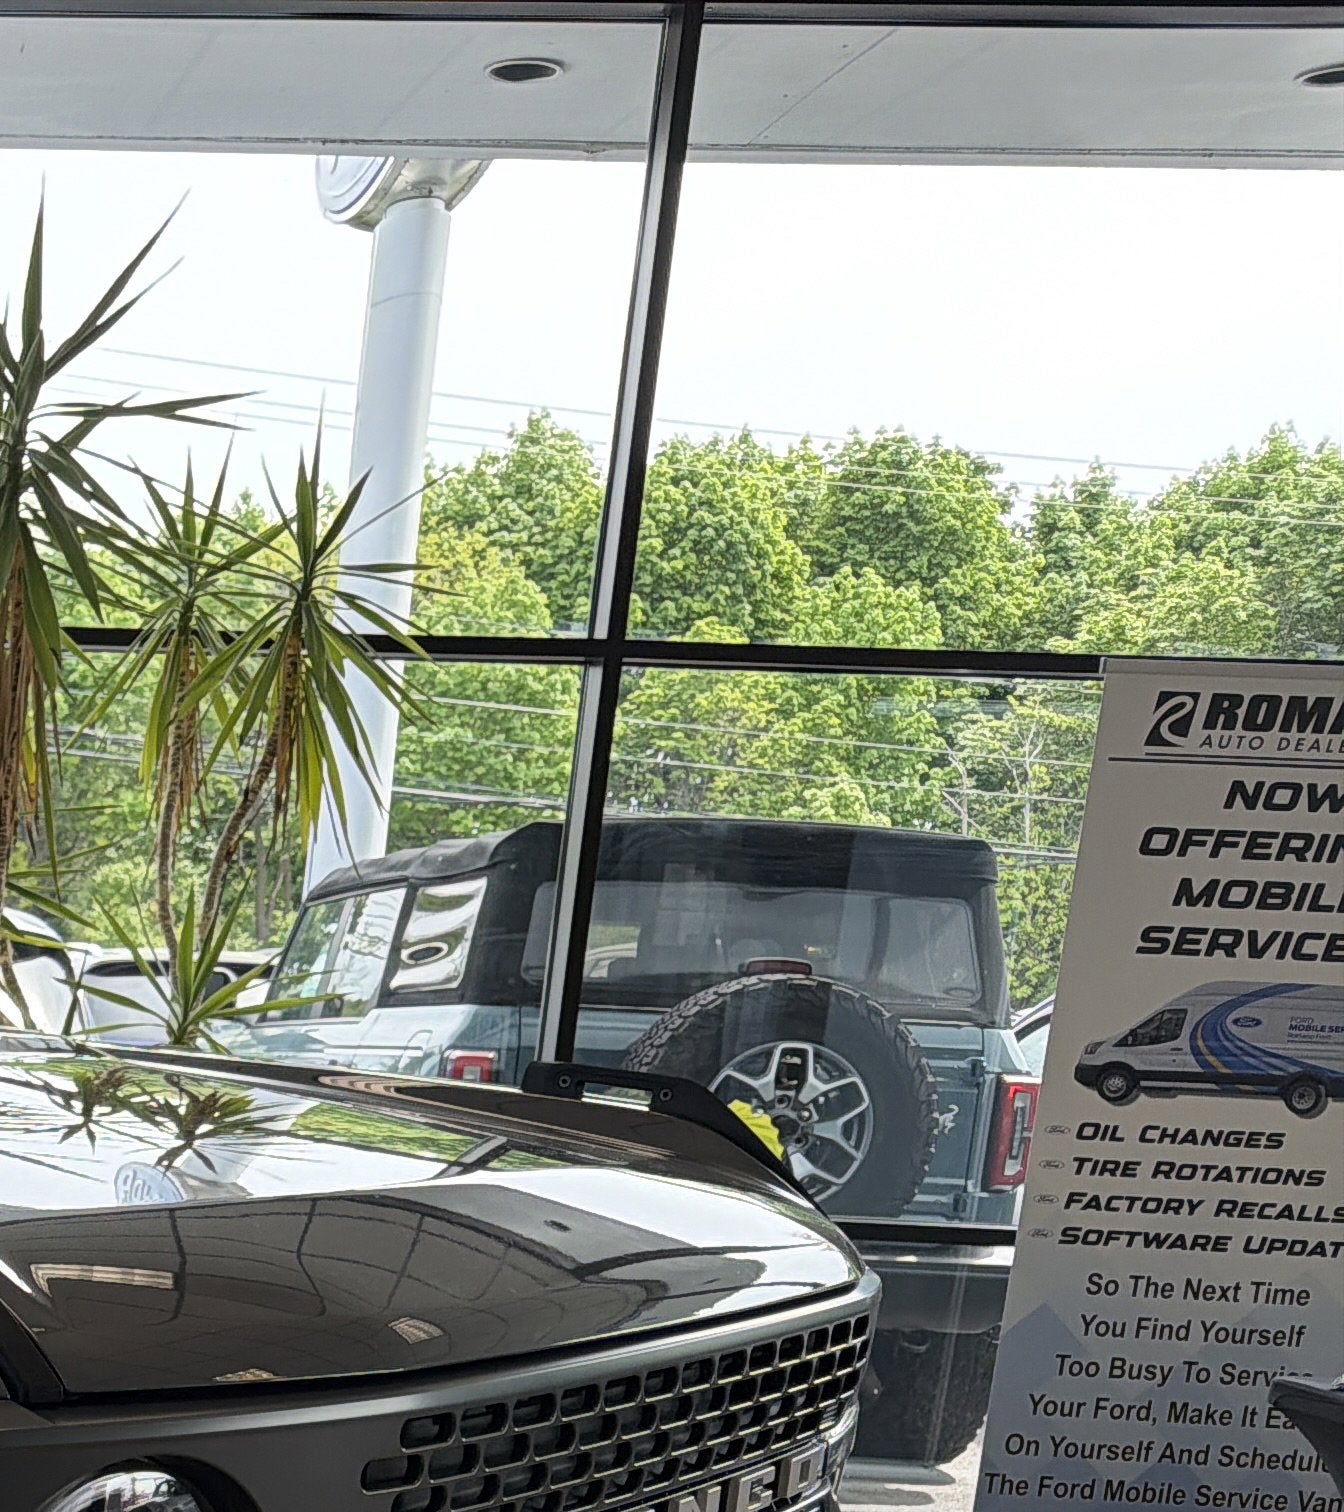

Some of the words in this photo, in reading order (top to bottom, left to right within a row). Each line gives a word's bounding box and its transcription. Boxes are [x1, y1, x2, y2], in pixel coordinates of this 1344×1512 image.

[1200, 734, 1265, 751] AUTO
[1223, 780, 1344, 814] NOW
[1288, 1023, 1326, 1033] MOBILE
[1075, 1122, 1125, 1142] OIL
[1138, 1124, 1286, 1150] CHANGES
[1073, 1157, 1141, 1178] TIRE
[1151, 1161, 1326, 1187] ROTATIONS
[1064, 1192, 1205, 1217] FACTORY
[1058, 1226, 1233, 1253] SOFTWARE
[1085, 1273, 1119, 1296] So
[1129, 1275, 1175, 1300] The
[1183, 1278, 1241, 1302] Next
[1250, 1281, 1311, 1307] Time
[1080, 1314, 1126, 1338] You
[1135, 1317, 1192, 1341] Find
[1200, 1320, 1307, 1347] Yourself
[1055, 1354, 1100, 1378] Too
[1109, 1357, 1173, 1387] Busy
[1183, 1361, 1210, 1384] To
[1029, 1394, 1087, 1418] Your
[1093, 1397, 1158, 1426] Ford,
[1167, 1401, 1232, 1428] Make
[1241, 1405, 1257, 1428] It
[1004, 1433, 1040, 1456] On
[1050, 1436, 1154, 1463] Yourself
[1158, 1442, 1209, 1466] And
[985, 1473, 1029, 1496] The
[1037, 1476, 1095, 1500] Ford
[1103, 1479, 1186, 1506] Mobile
[1195, 1485, 1288, 1512] Service
